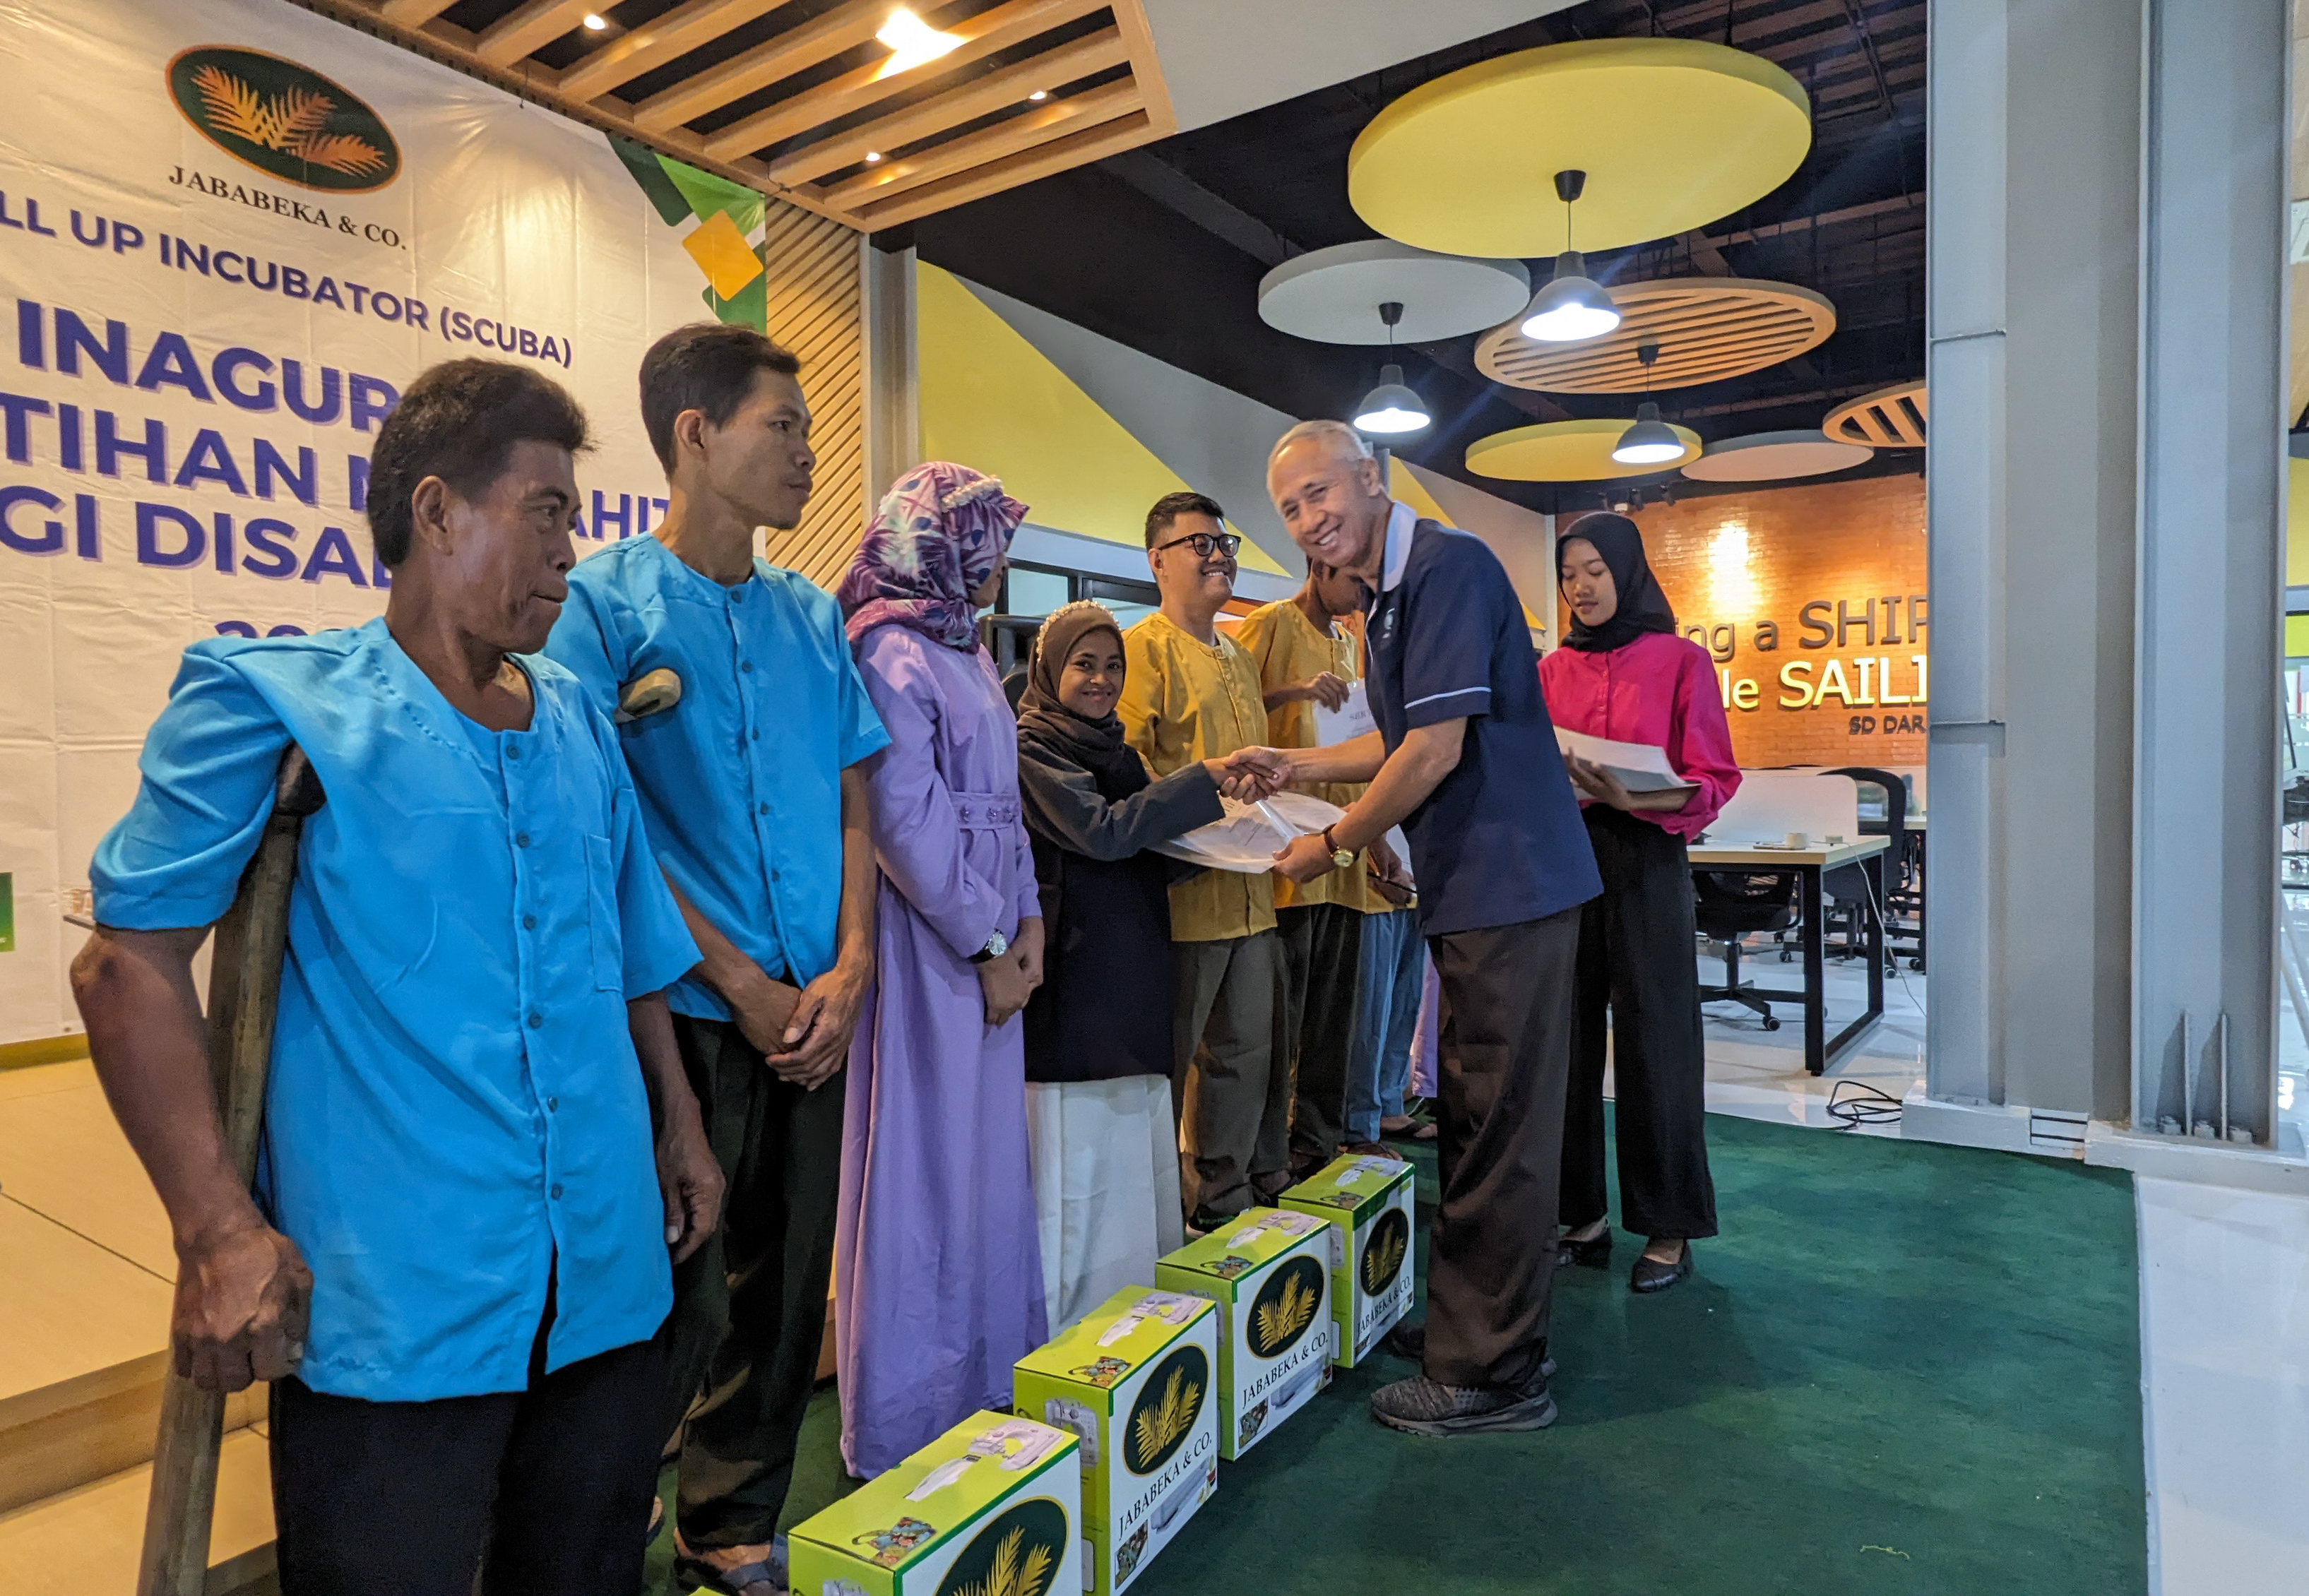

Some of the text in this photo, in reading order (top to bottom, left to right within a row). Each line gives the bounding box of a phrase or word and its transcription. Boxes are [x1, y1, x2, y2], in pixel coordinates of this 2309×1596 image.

[169, 165, 407, 250] JABABEKA & CO.
[70, 209, 145, 255] UP
[160, 233, 429, 331] INCUBATOR
[439, 306, 572, 369] (SCUBA)
[17, 299, 403, 433] INAGUR
[0, 392, 319, 508] TIHAN
[136, 501, 392, 589] DISA
[1754, 620, 1779, 651] a
[1721, 654, 1928, 710] le SAILI
[1242, 1332, 1329, 1410] JABABEKA & CO.
[1119, 1431, 1212, 1541] JABABEKA & CO.
